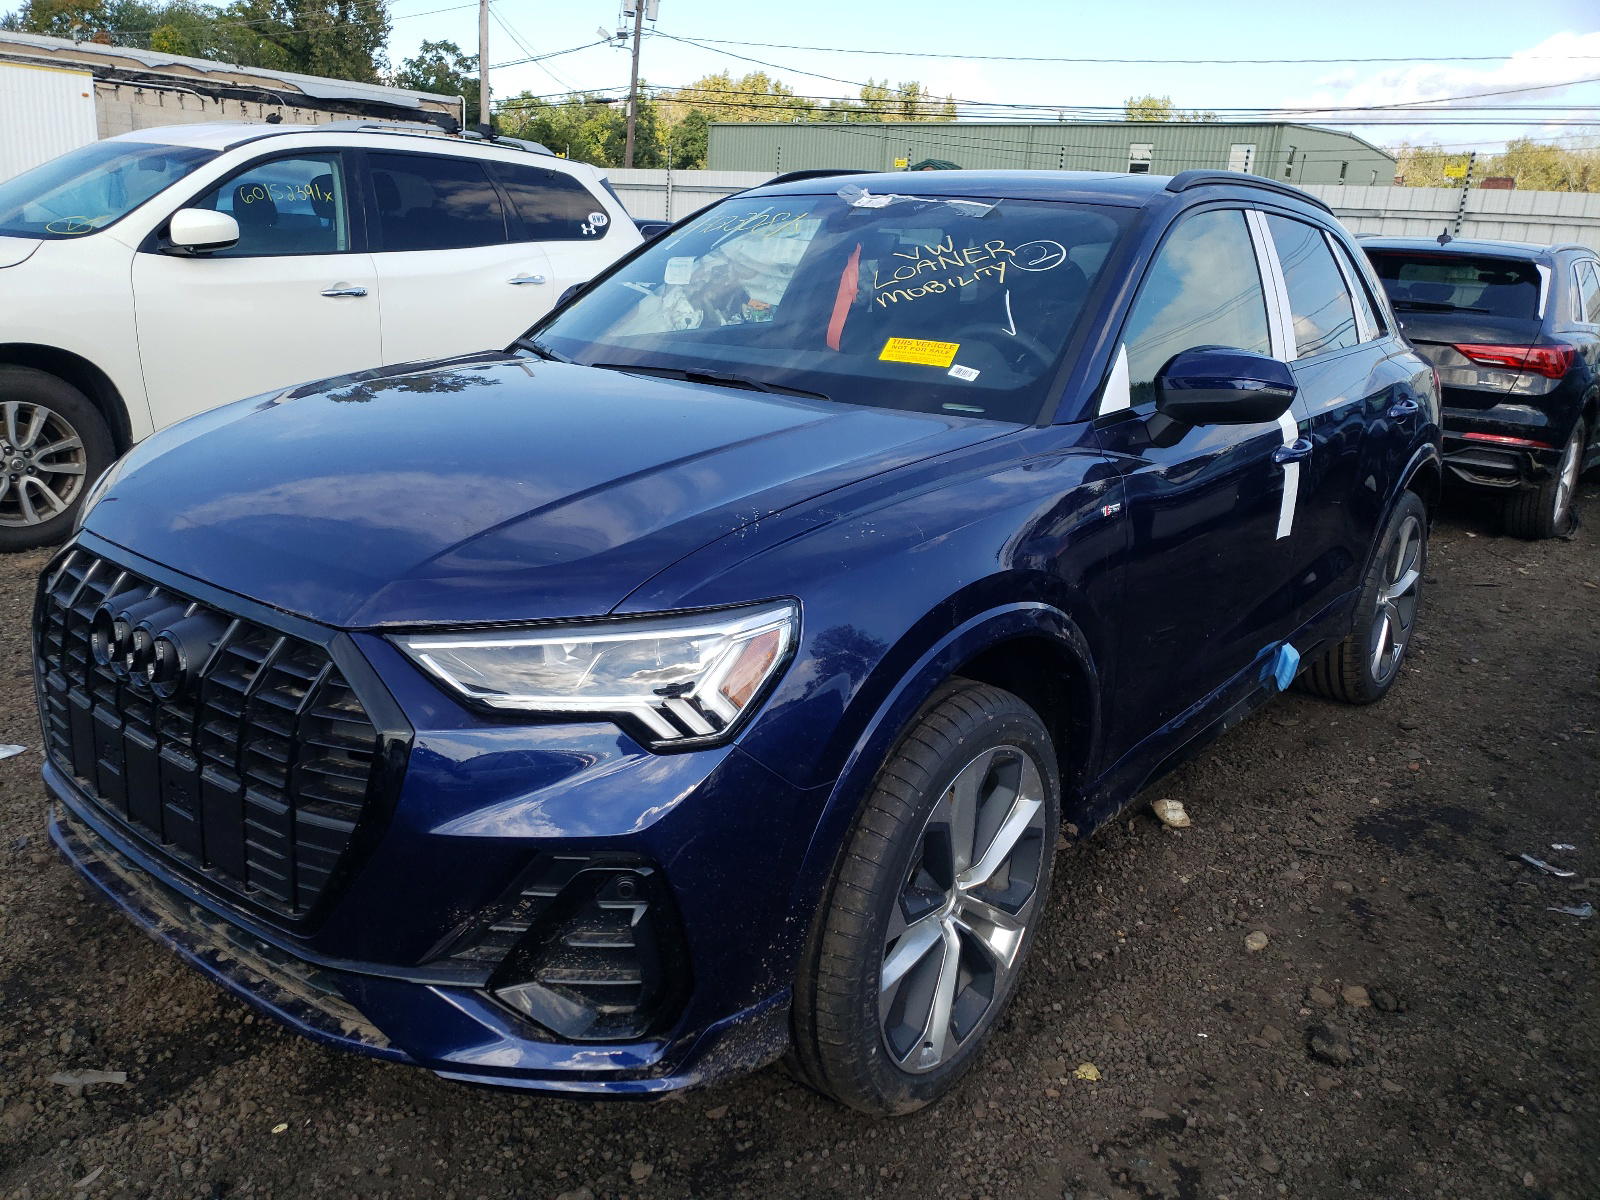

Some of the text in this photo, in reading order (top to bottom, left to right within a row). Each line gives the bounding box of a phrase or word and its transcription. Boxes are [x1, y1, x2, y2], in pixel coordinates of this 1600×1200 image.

[874, 240, 1016, 290] LOANER
[876, 261, 1006, 308] MOBILITY
[892, 338, 956, 350] THIS VEHICLE
